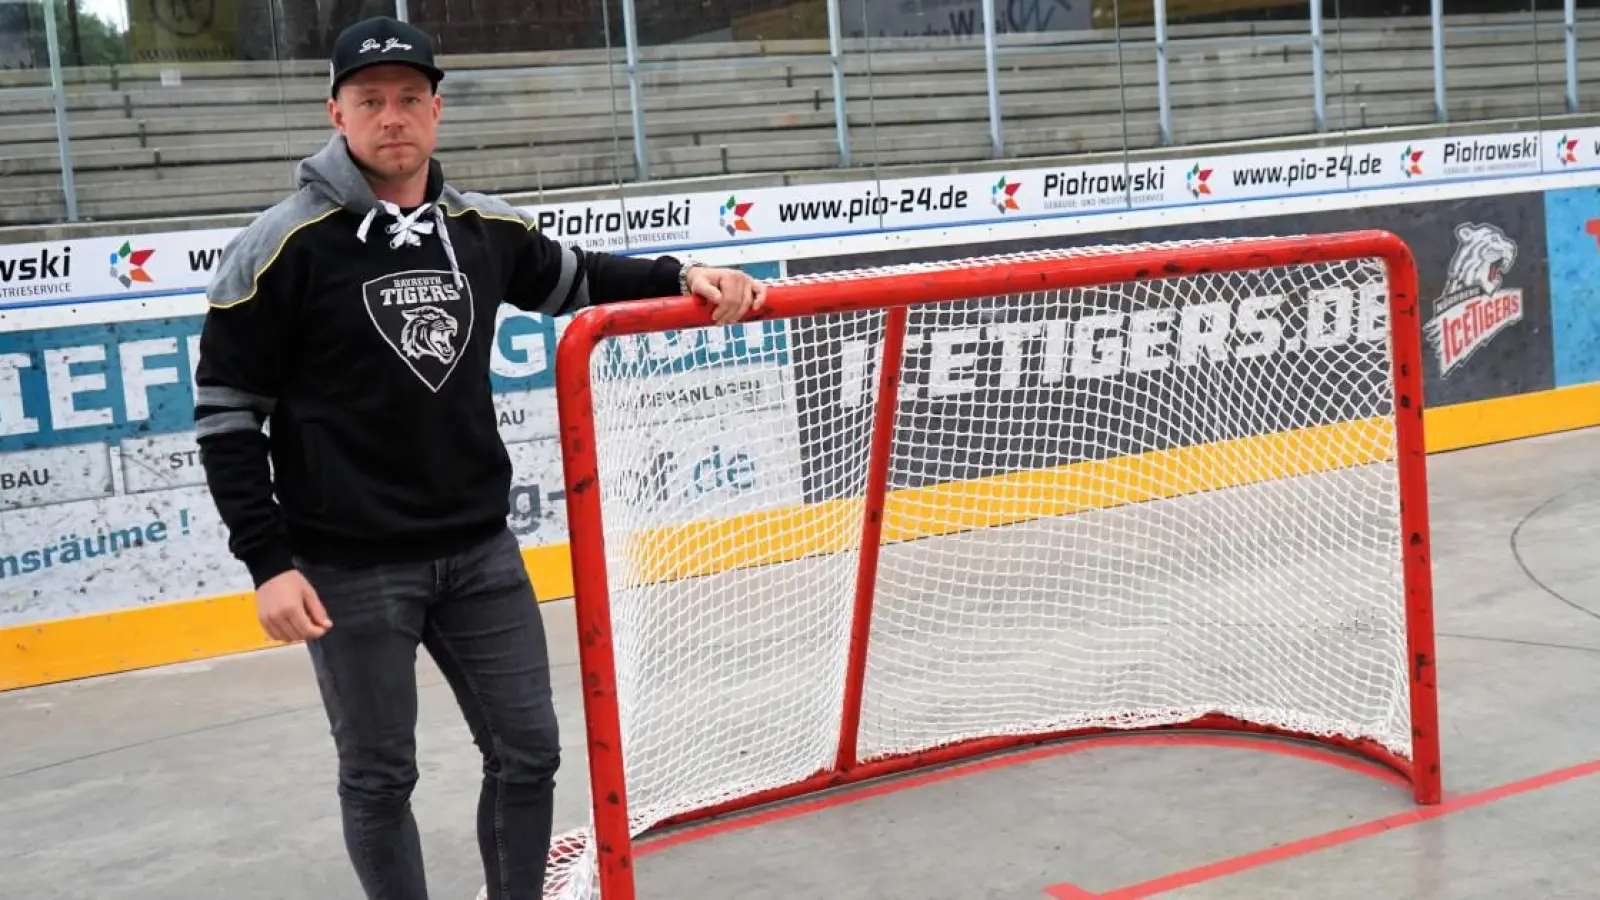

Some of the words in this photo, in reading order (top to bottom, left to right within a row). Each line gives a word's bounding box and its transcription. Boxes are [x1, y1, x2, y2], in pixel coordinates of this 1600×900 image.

[1443, 136, 1538, 164] Piotrowski
[1043, 165, 1165, 198] Piotrowski
[1233, 152, 1381, 188] www.pio-24.de
[537, 198, 691, 236] Piotrowski
[779, 184, 968, 224] www.pio-24.de
[380, 284, 460, 306] TIGERS
[1, 469, 50, 490] BAU
